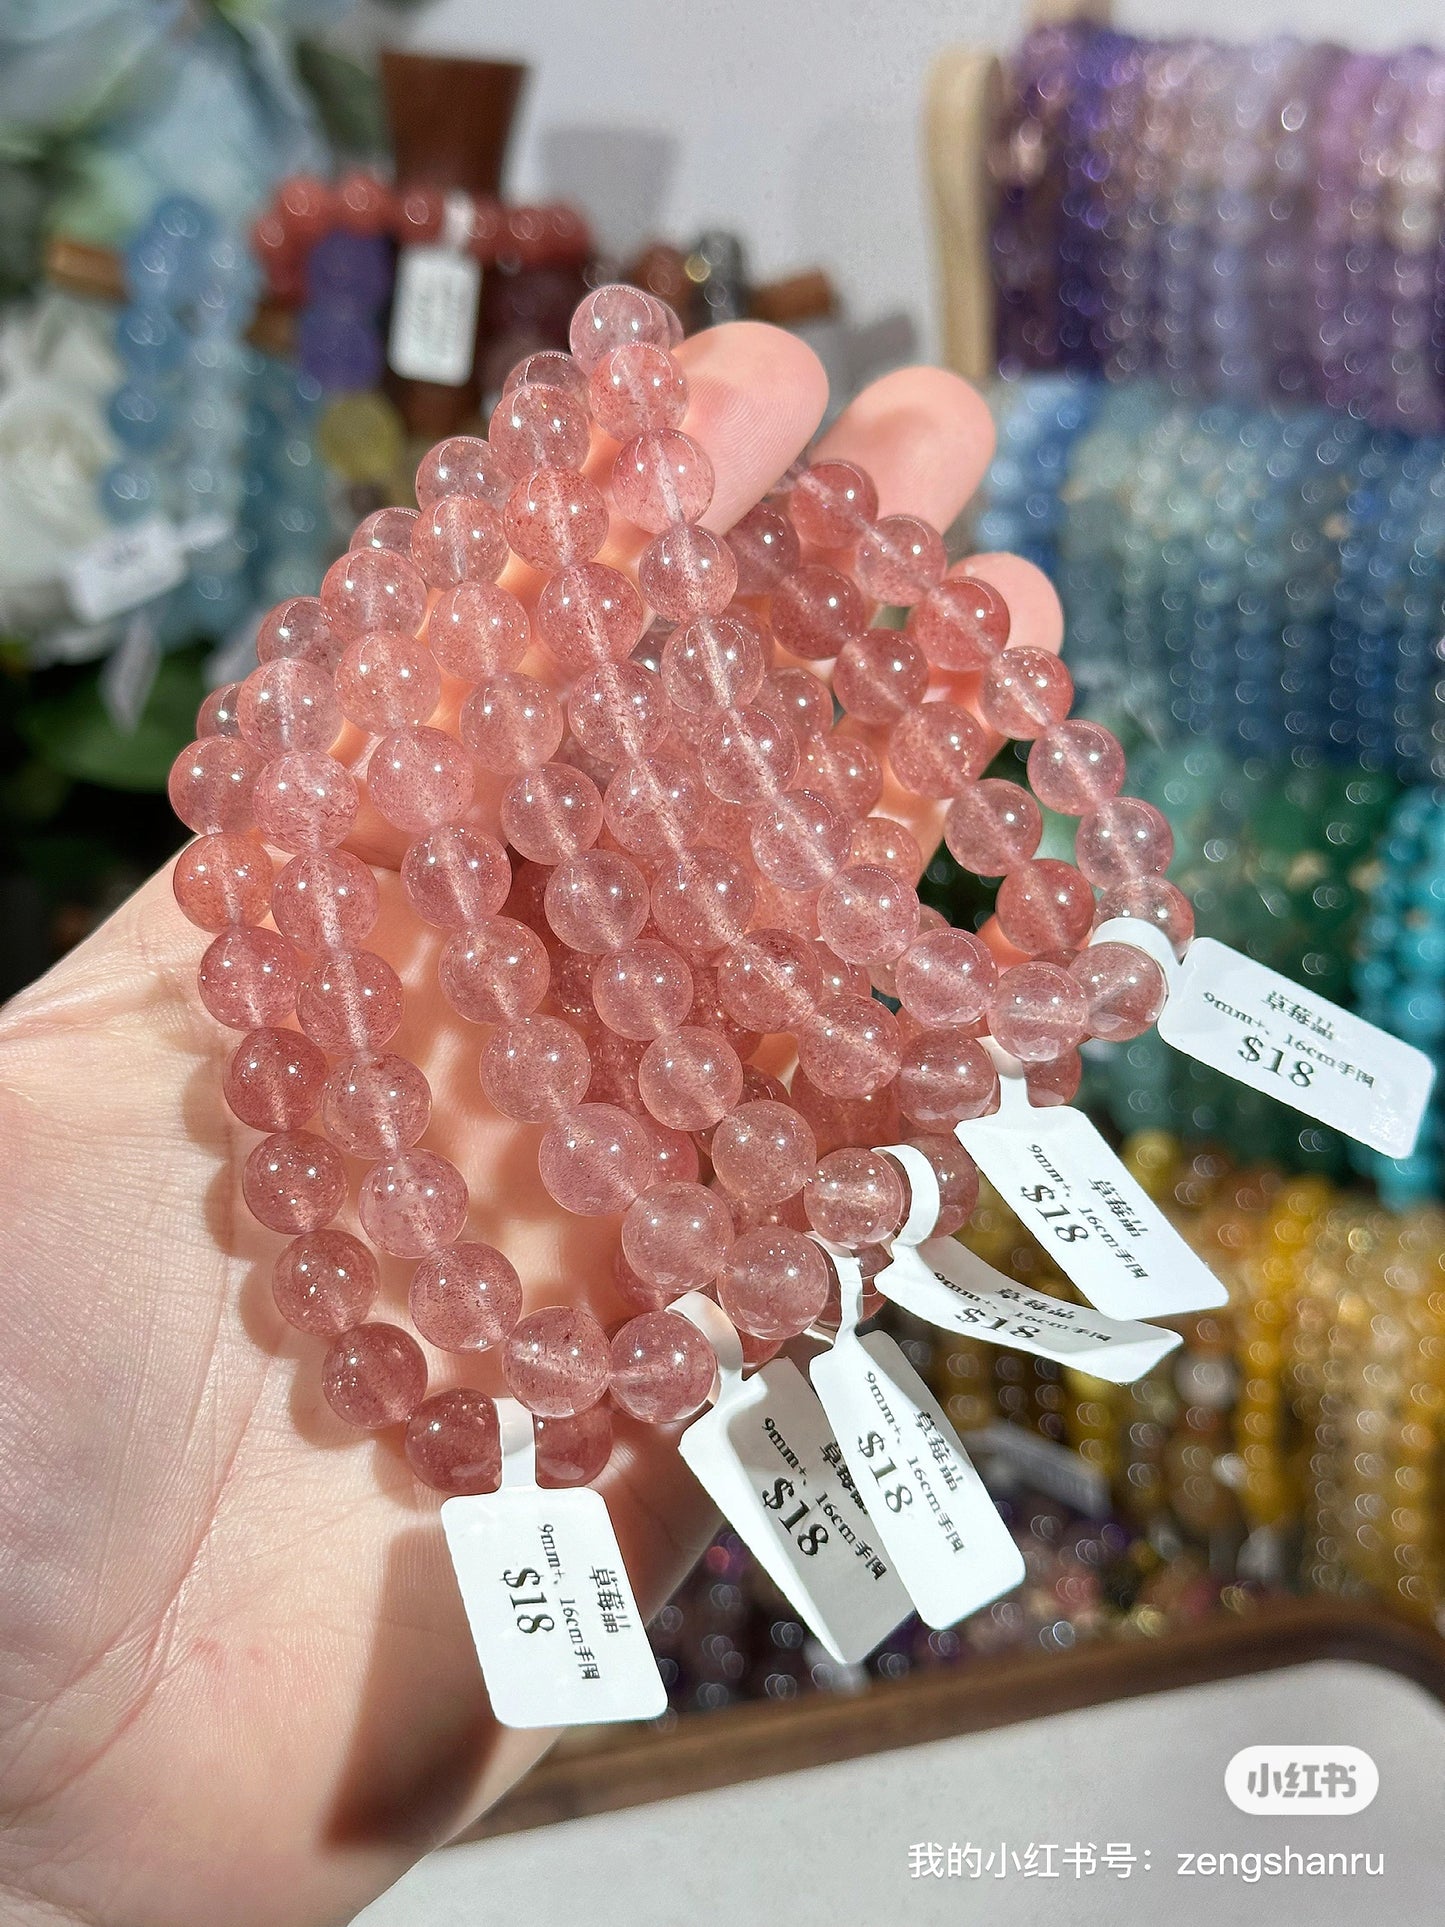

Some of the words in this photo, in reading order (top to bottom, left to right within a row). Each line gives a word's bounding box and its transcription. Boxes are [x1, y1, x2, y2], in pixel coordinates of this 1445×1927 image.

[1237, 1034, 1314, 1088] $18
[1020, 1184, 1089, 1243] $18
[954, 1307, 1041, 1340] $18
[858, 1430, 913, 1514] $18
[762, 1477, 829, 1556] $18
[500, 1566, 555, 1634] $18
